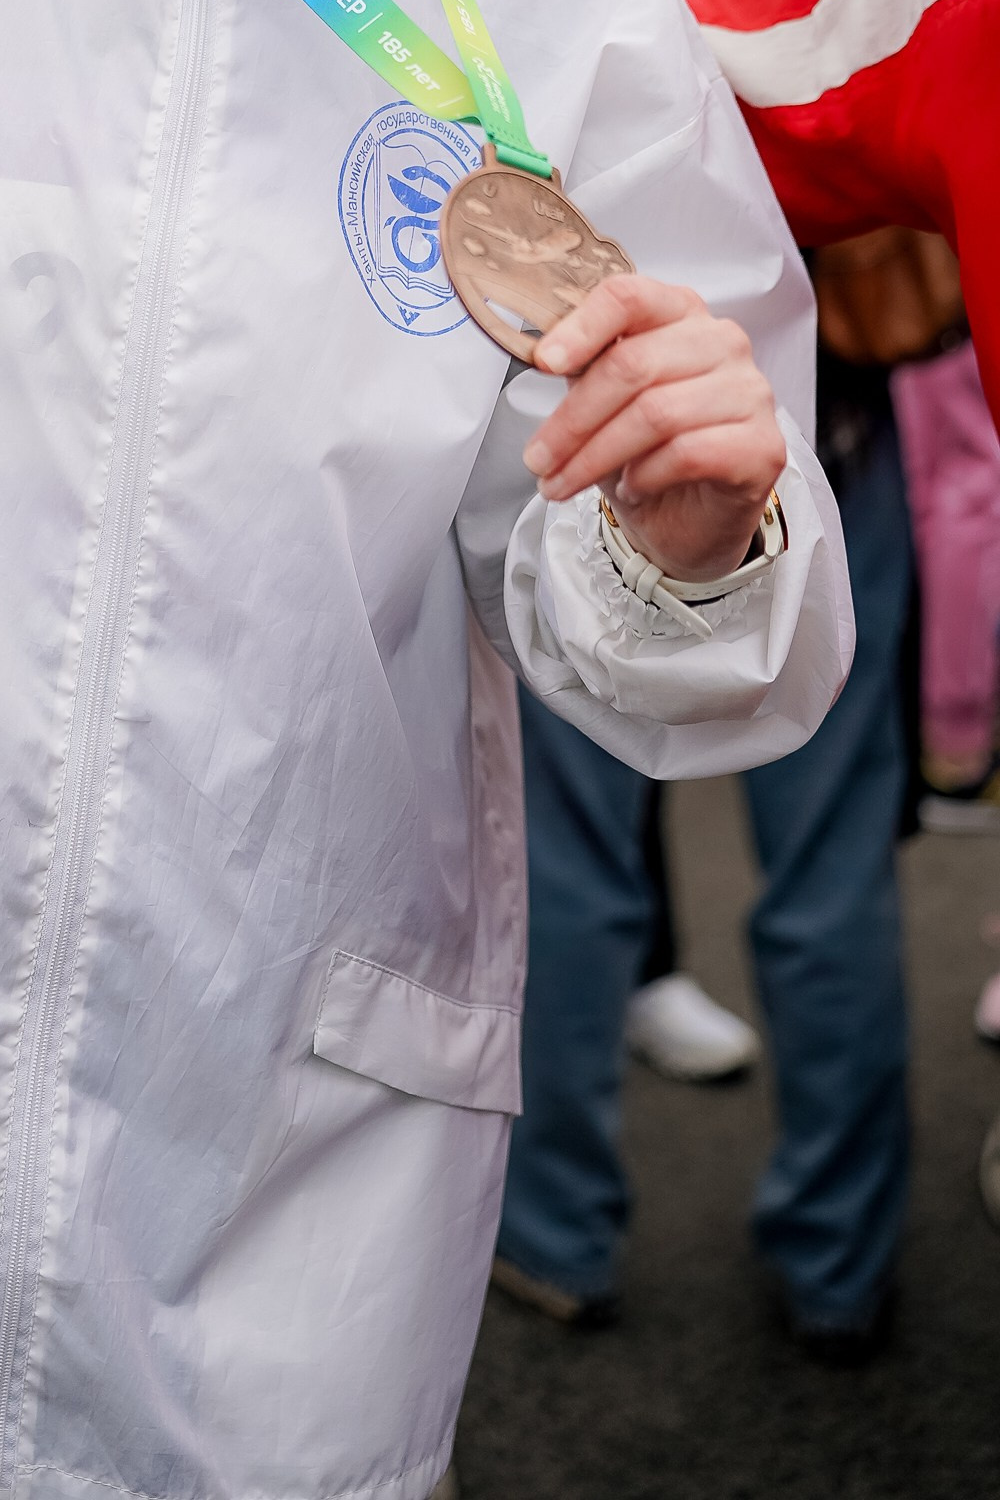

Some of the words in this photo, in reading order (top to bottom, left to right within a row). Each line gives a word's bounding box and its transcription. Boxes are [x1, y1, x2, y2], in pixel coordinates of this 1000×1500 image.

[377, 30, 412, 63] 185
[405, 63, 440, 91] лет
[347, 132, 377, 288] Ханты-Мансийская
[376, 110, 471, 158] государственная
